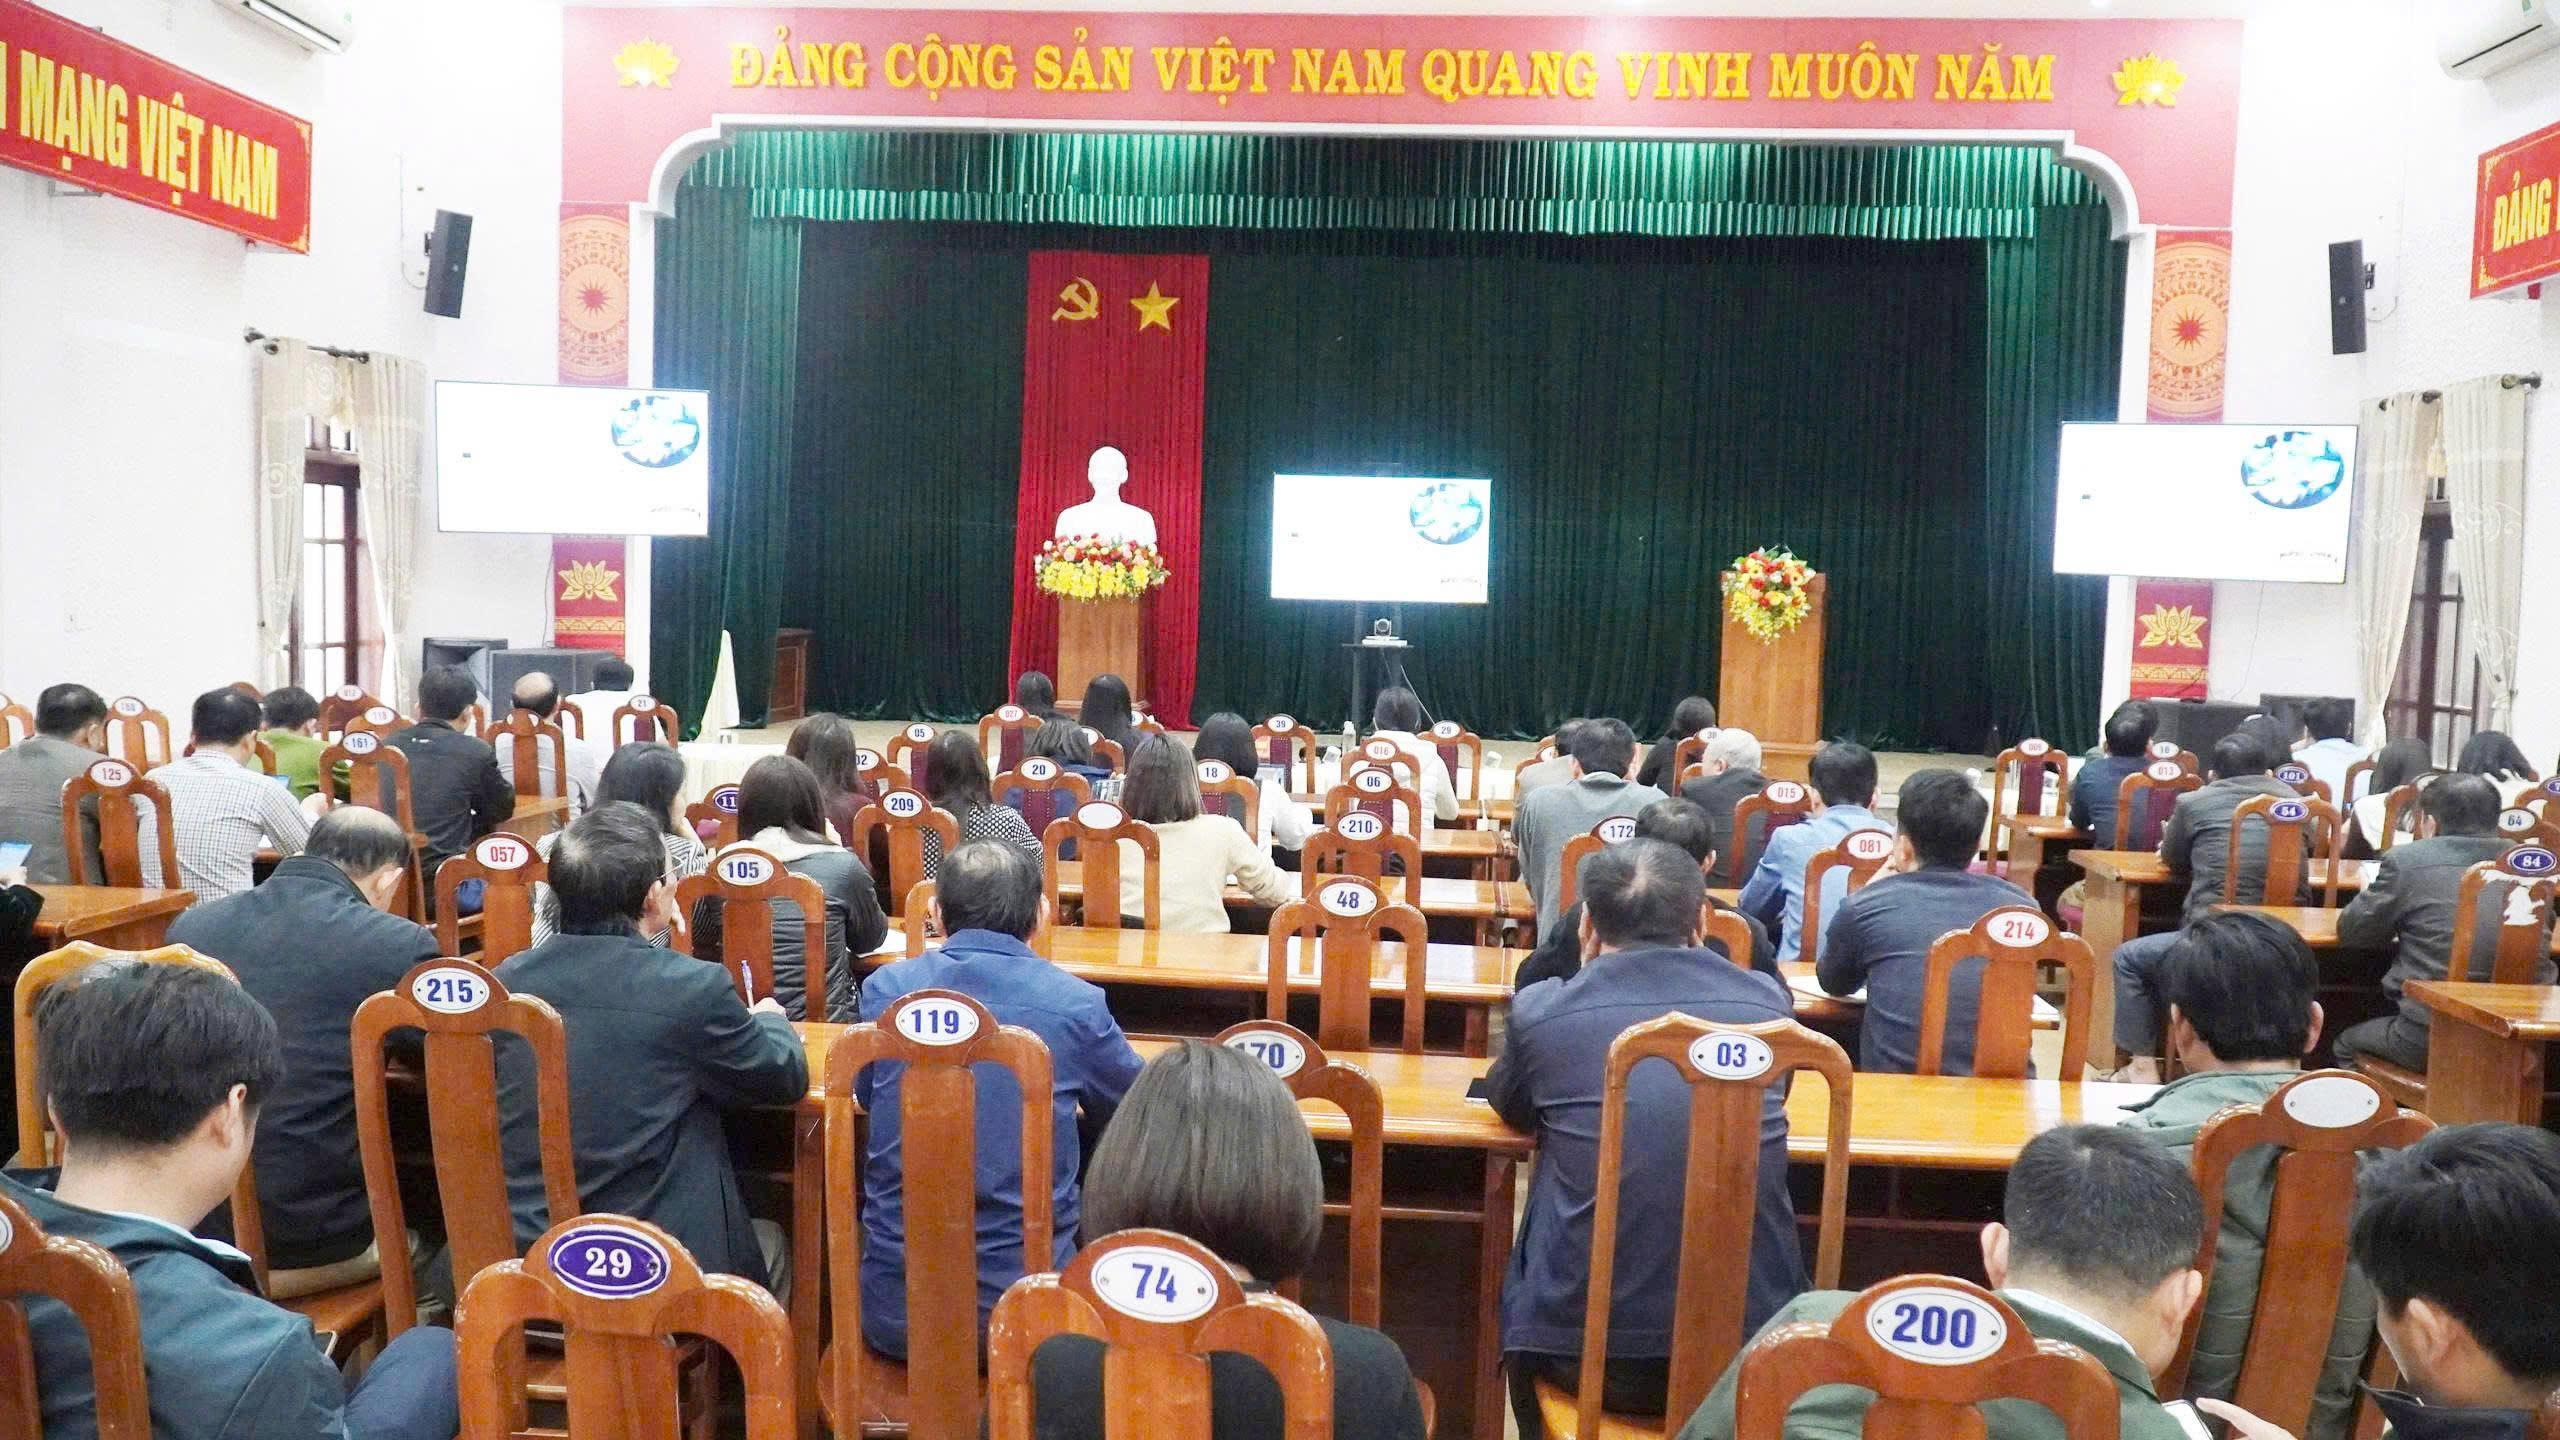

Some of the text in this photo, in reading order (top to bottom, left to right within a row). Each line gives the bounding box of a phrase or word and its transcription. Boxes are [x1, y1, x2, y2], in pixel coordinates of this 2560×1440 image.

[729, 25, 2056, 105] ĐẢNG CỘNG SẢN VIỆT NAM QUANG VINH MUÔN NĂM
[20, 49, 128, 171] MẠNG
[138, 91, 204, 206] VIỆT
[211, 124, 278, 219] NAM
[2493, 171, 2552, 253] ĐẢNG
[1276, 720, 1286, 728] 39
[914, 728, 925, 738] 05
[352, 738, 368, 748] 161
[102, 768, 121, 780] 125
[1033, 764, 1045, 776] 20
[1206, 767, 1217, 777] 18
[1367, 776, 1380, 787] 06
[1778, 787, 1795, 798] 015
[891, 797, 914, 812] 209
[1349, 820, 1372, 834] 210
[1611, 825, 1634, 838] 172
[1860, 840, 1881, 852] 081
[491, 847, 515, 862] 057
[2523, 855, 2540, 867] 84
[727, 862, 759, 880] 105
[1337, 891, 1359, 908] 48
[2004, 920, 2034, 939] 214
[427, 979, 472, 1003] 215
[911, 1009, 959, 1034] 119
[1717, 1042, 1747, 1068] 03
[585, 1247, 631, 1279] 29
[1131, 1264, 1176, 1302] 74
[1893, 1305, 1976, 1348] 200
